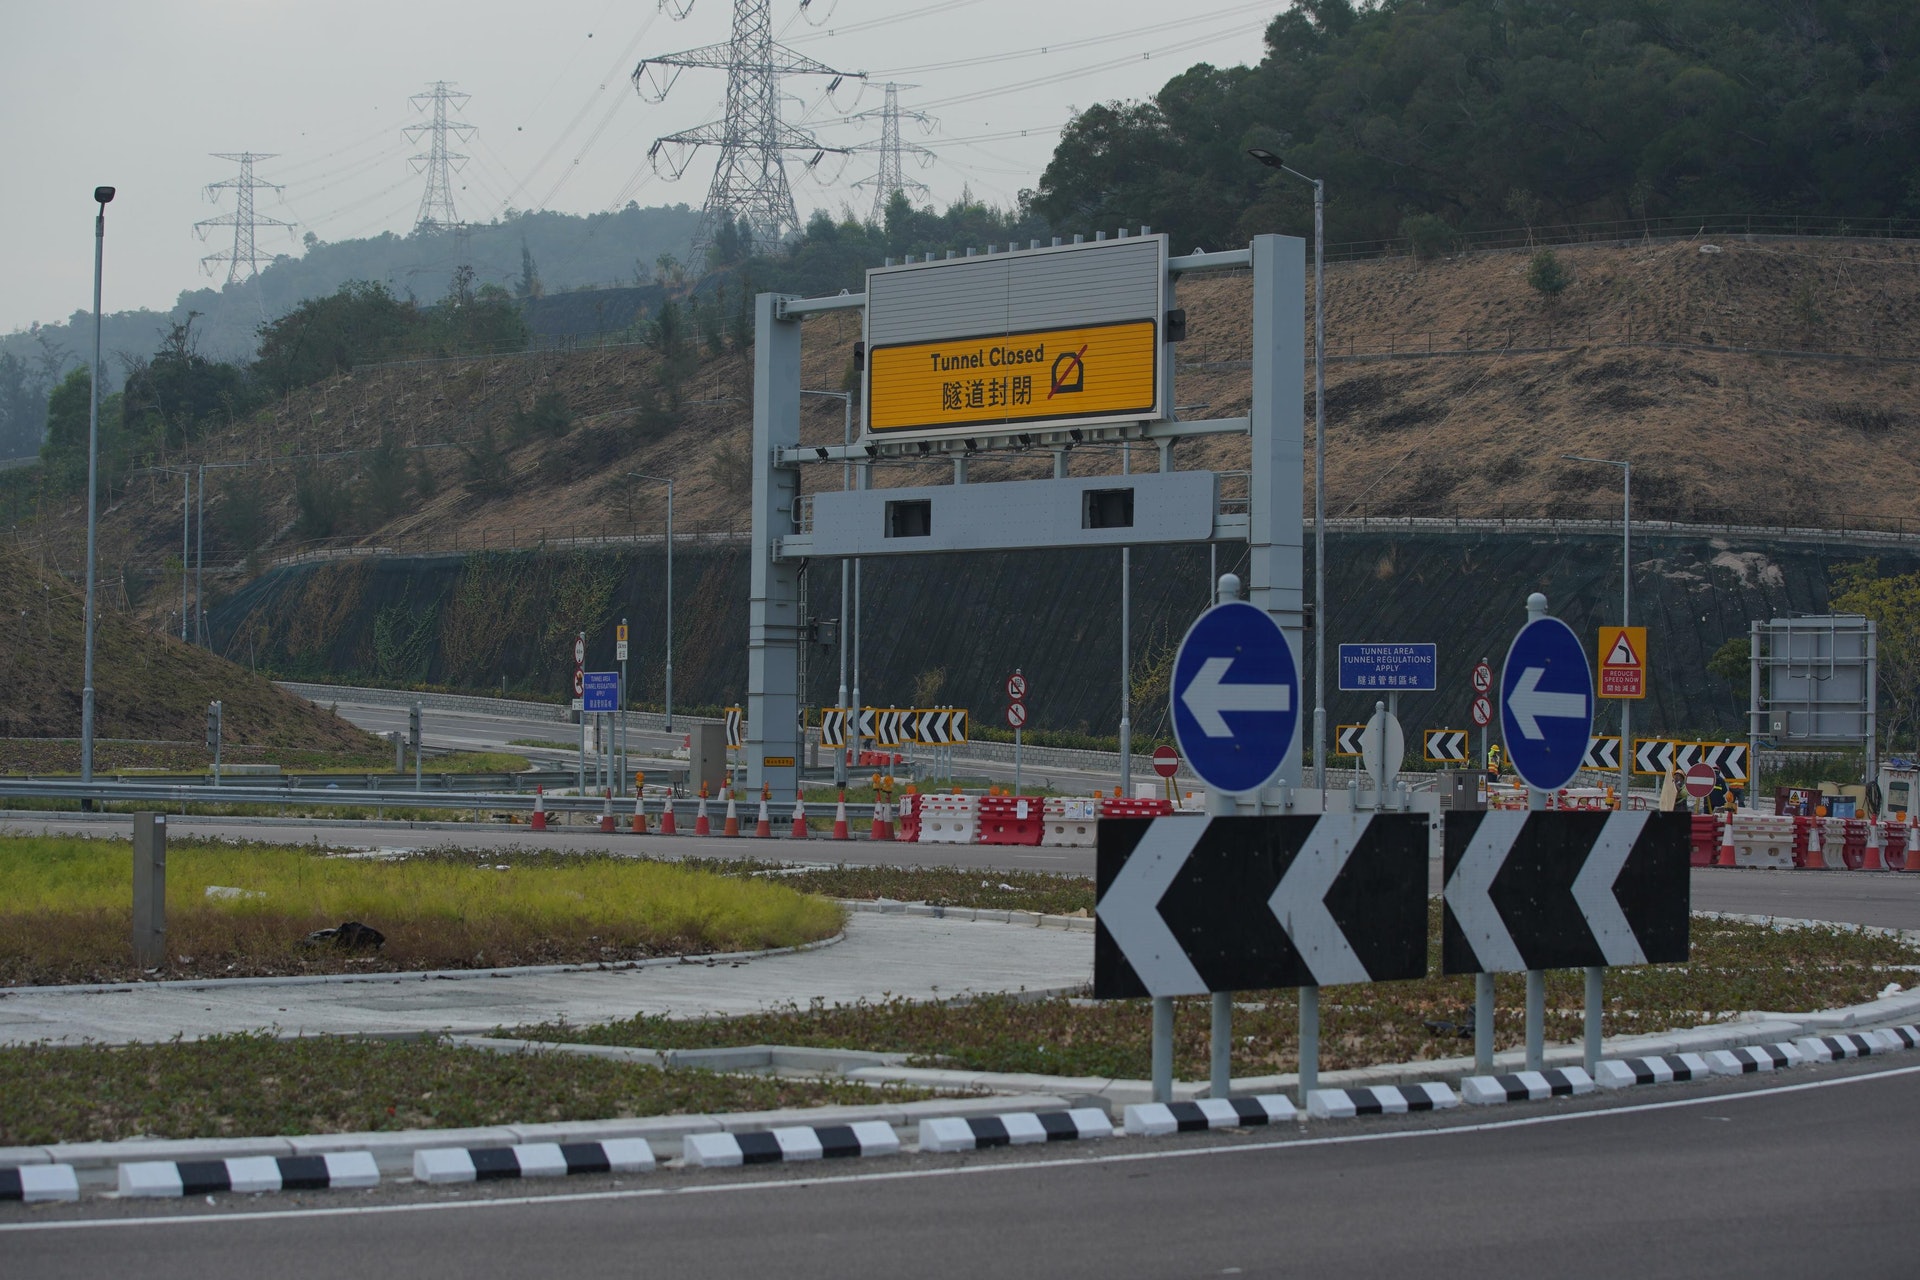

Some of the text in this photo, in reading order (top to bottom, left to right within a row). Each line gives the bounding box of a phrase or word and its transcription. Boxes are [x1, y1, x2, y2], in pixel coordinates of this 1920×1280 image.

[930, 343, 1044, 372] Tunnel Closed
[942, 375, 1032, 412] 隧道封閉
[1361, 647, 1414, 655] TUNNEL AREA
[1343, 655, 1432, 664] TUNNEL REGULATIONS
[1375, 664, 1400, 672] APPLY
